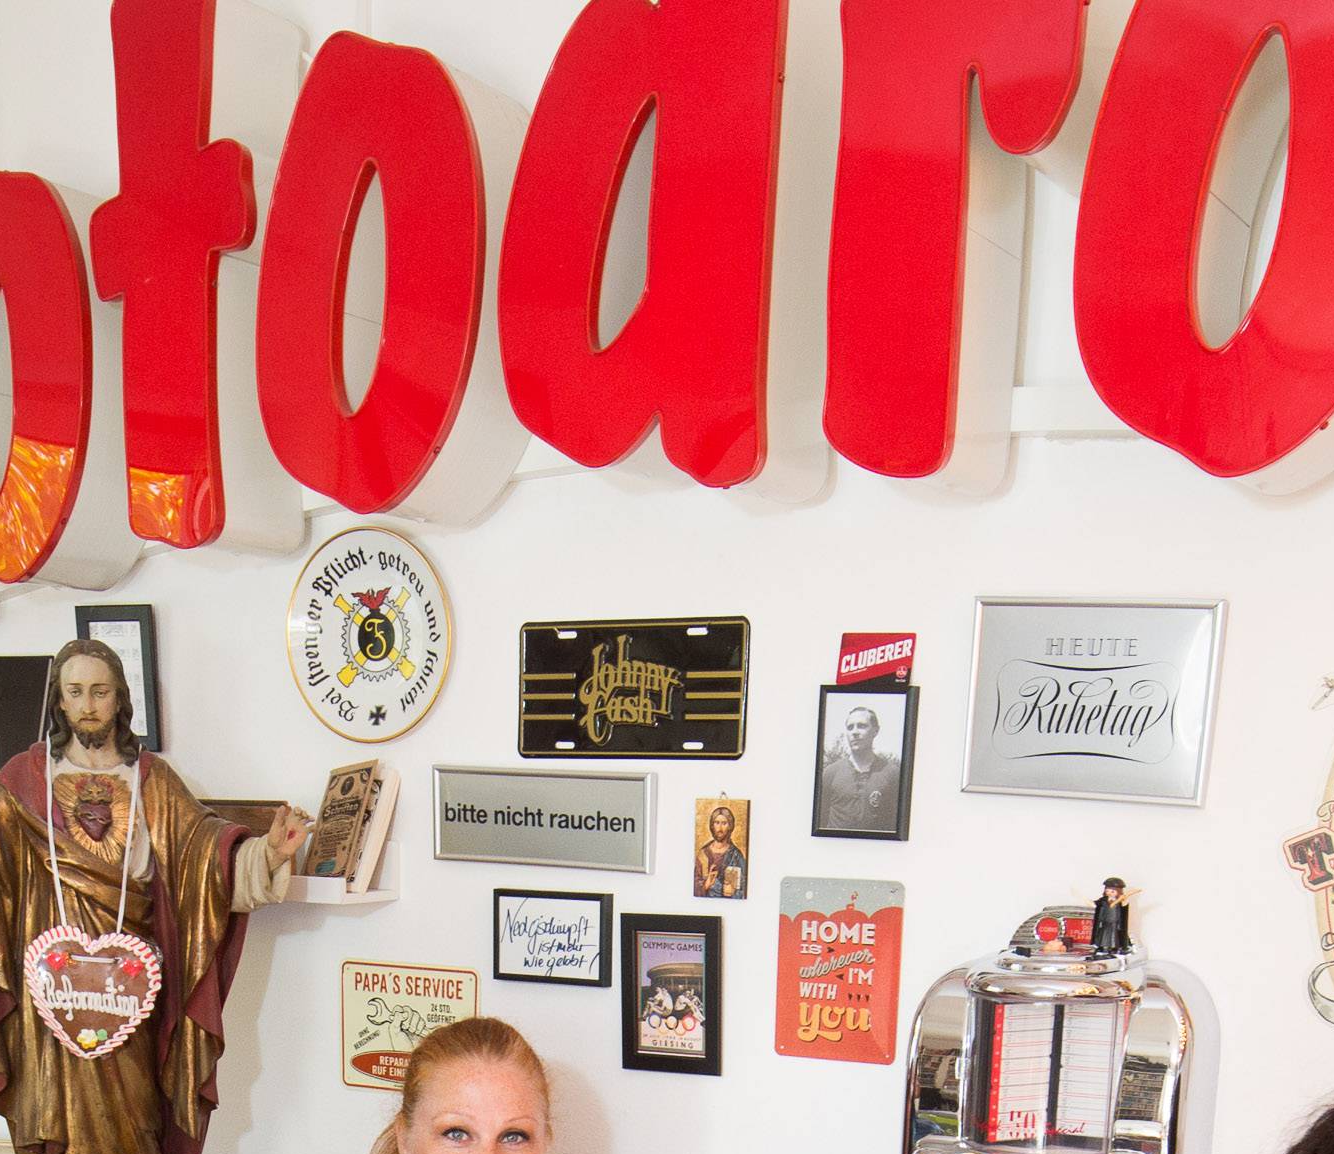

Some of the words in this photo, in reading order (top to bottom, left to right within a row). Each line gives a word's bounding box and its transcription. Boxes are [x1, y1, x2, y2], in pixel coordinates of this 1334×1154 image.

[321, 687, 359, 722] Bei
[424, 600, 441, 643] und
[841, 638, 913, 674] CLUBERER
[1045, 637, 1139, 657] HEUTE
[578, 634, 684, 717] Johnny
[578, 686, 655, 745] Cash
[1002, 676, 1169, 748] Ruhetag
[444, 802, 488, 824] bitte
[493, 806, 544, 828] nicht
[549, 811, 636, 833] rauchen
[642, 941, 675, 951] OLYMPIC
[676, 943, 703, 952] GAMES
[800, 919, 876, 946] HOME
[800, 944, 823, 955] IS
[799, 949, 876, 979] wherever
[848, 967, 875, 986] I'M
[41, 971, 140, 1021] Reformation
[405, 975, 464, 1000] SERVICE
[799, 981, 838, 1001] WITH
[430, 1003, 438, 1013] 24
[797, 1002, 872, 1043] you
[372, 1065, 386, 1076] RUF
